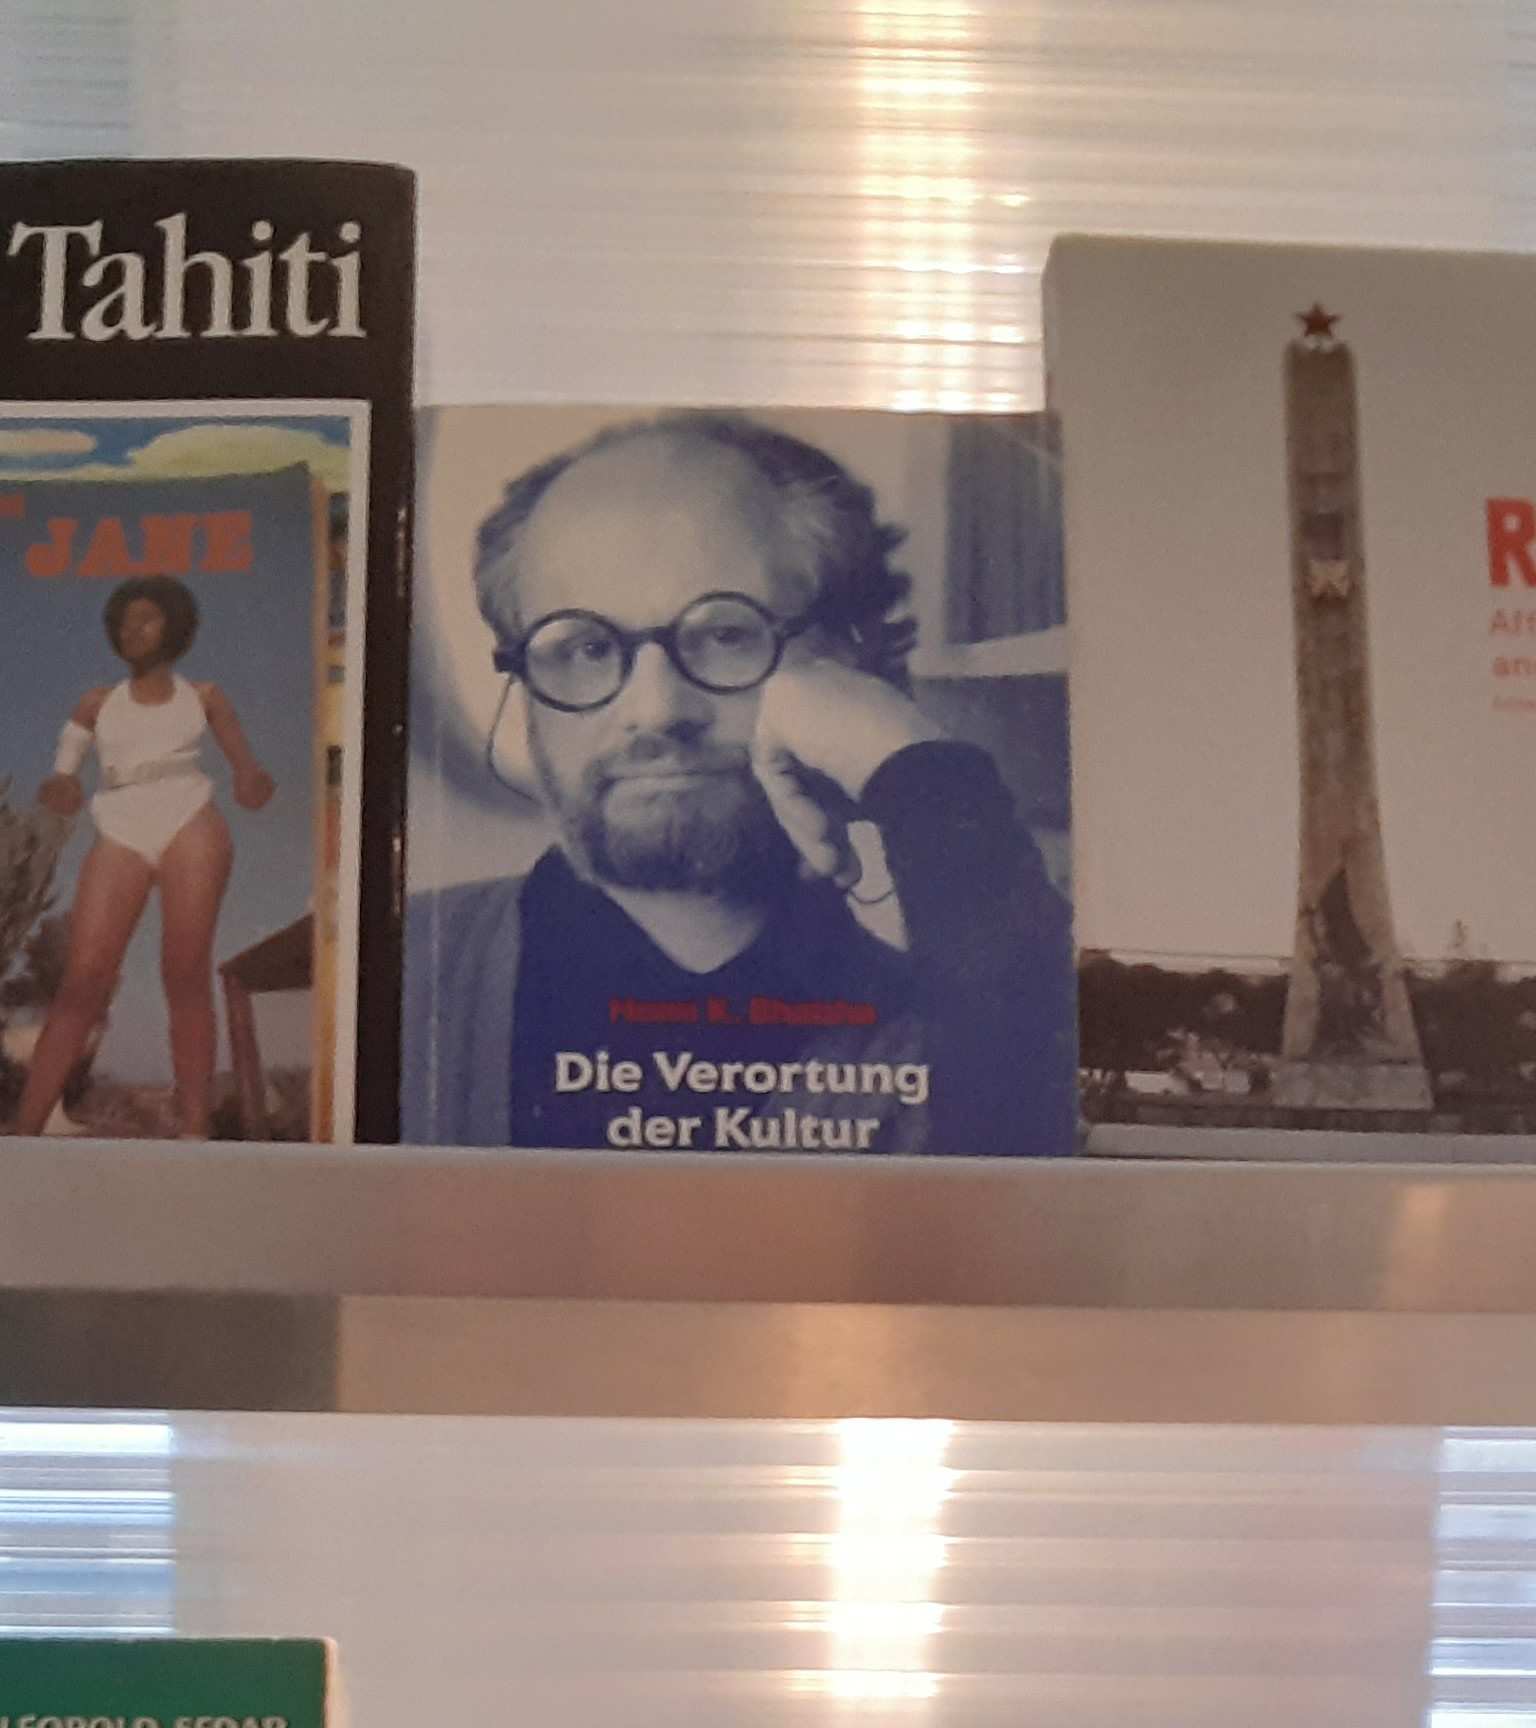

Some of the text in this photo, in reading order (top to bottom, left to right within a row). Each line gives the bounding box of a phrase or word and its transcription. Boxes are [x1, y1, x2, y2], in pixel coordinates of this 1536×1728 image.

[8, 213, 366, 341] Tahiti
[24, 511, 255, 577] JANE
[556, 1050, 929, 1105] Die Verortung
[606, 1103, 879, 1150] der Kultur
